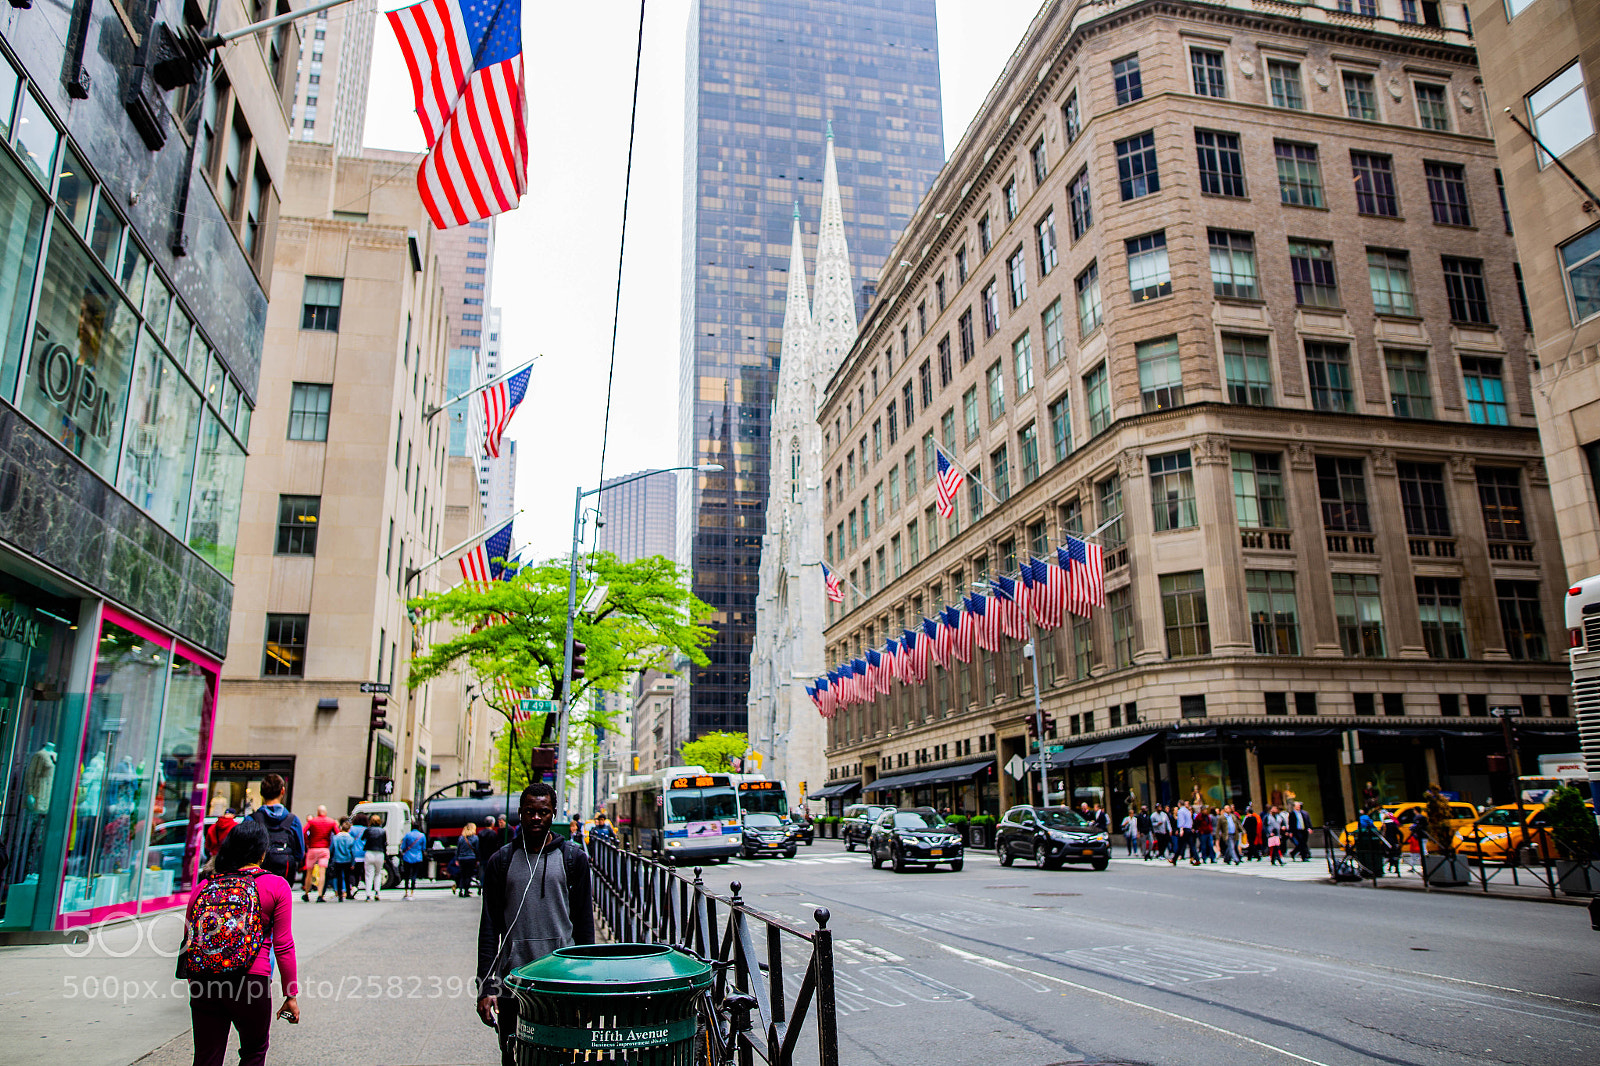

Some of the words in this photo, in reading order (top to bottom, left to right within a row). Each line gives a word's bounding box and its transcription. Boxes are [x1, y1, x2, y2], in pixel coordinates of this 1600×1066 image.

[522, 701, 529, 710] W
[532, 701, 544, 710] 49
[230, 761, 260, 770] KORS
[591, 1030, 623, 1042] Fifth
[626, 1028, 669, 1041] Avenue
